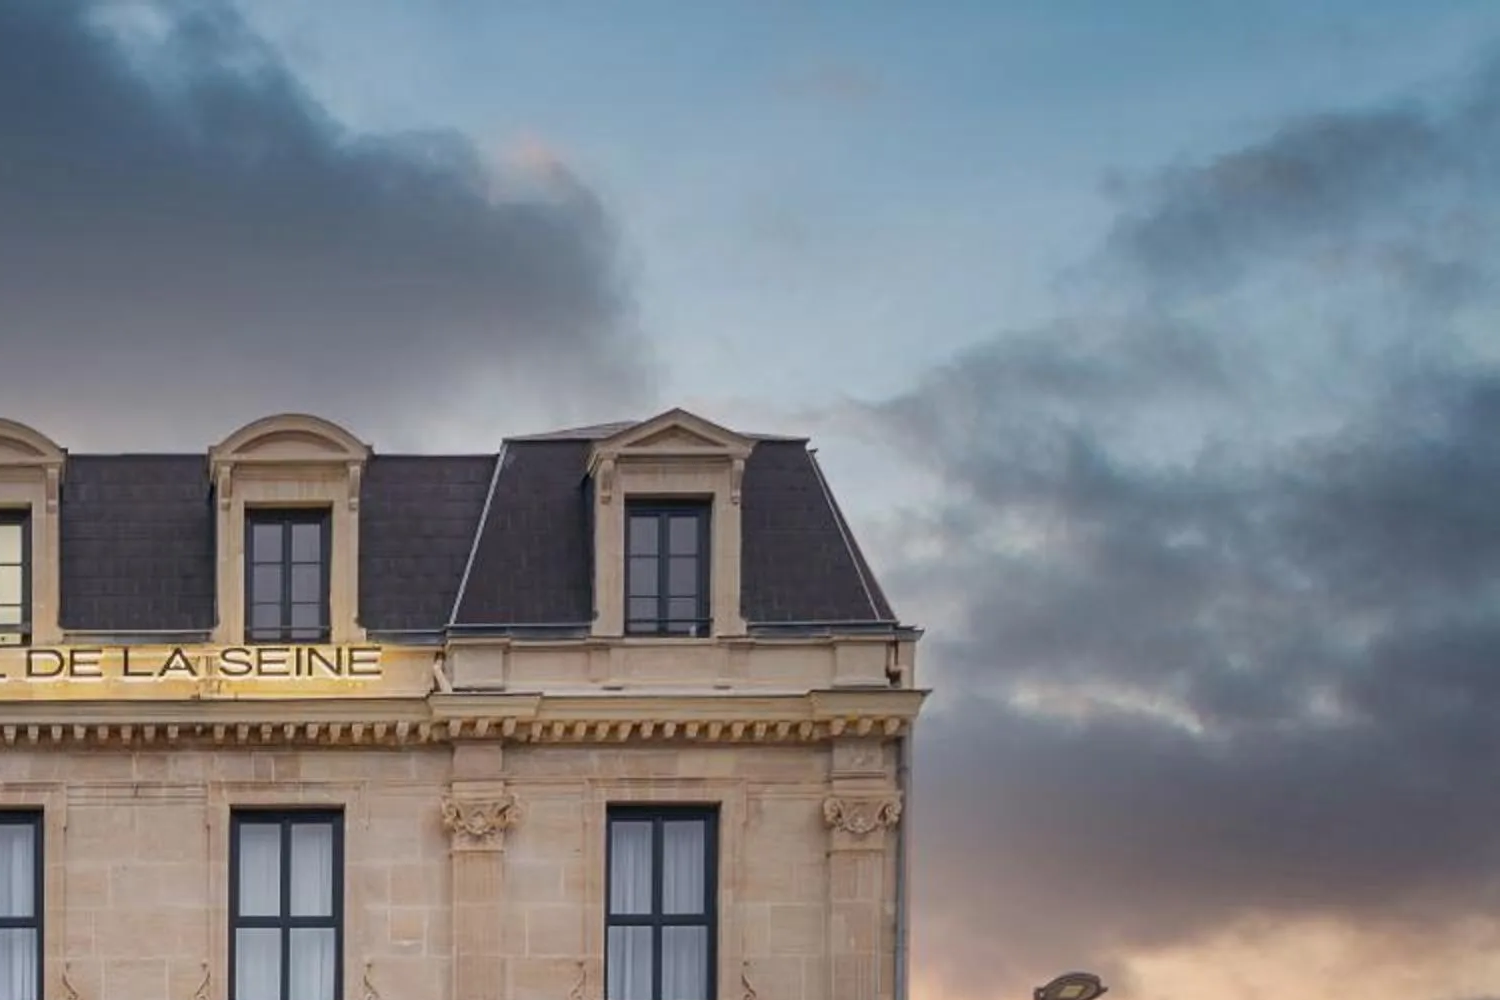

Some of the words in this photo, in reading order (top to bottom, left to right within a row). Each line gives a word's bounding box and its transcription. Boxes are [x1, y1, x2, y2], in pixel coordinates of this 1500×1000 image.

[25, 649, 103, 677] DE
[123, 646, 197, 677] LA
[219, 646, 383, 677] SEINE
